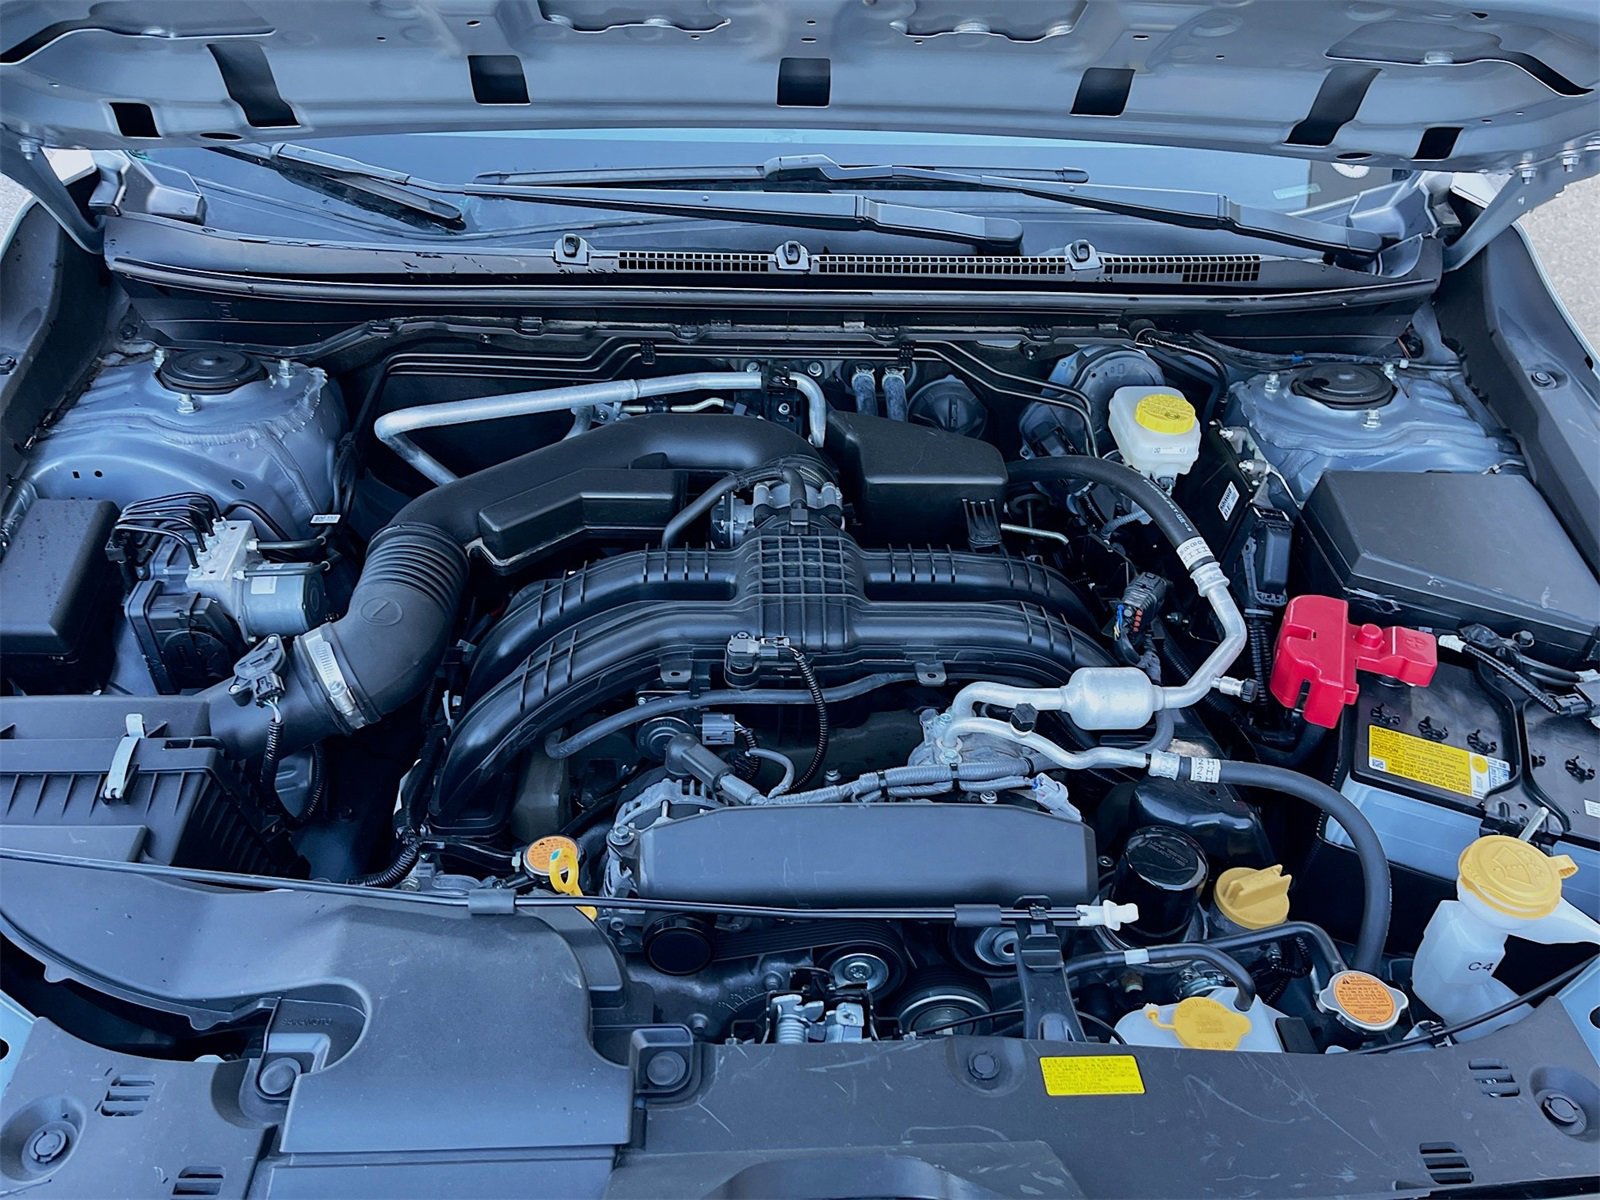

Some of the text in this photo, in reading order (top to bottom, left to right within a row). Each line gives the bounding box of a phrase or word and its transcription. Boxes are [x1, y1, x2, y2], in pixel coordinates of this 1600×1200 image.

[1371, 726, 1399, 738] DANGER
[1371, 741, 1398, 753] POISON
[1468, 962, 1494, 971] C4
